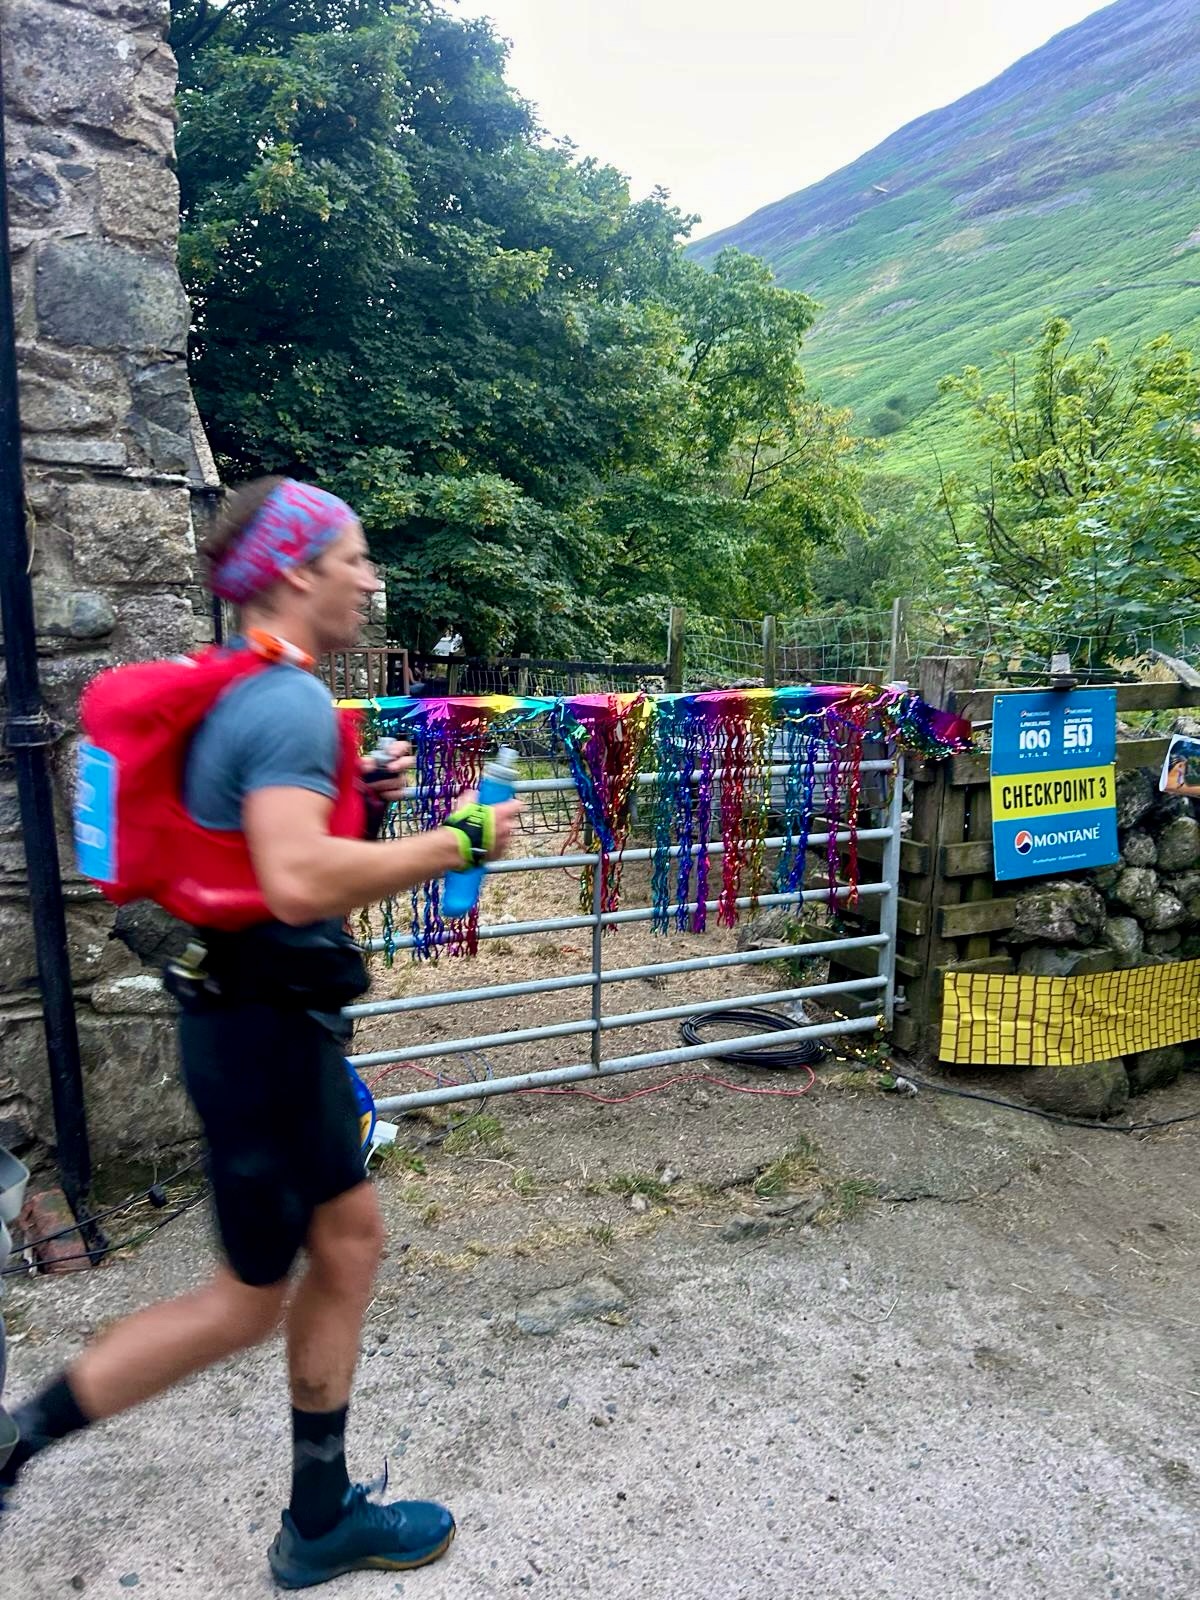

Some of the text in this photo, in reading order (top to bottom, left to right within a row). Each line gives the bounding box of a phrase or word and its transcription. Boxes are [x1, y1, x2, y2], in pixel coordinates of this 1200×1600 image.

[1020, 729, 1051, 750] 100
[1063, 724, 1093, 748] 50
[1002, 776, 1107, 810] CHECKPOINT 3
[1034, 826, 1100, 848] MONTANE
